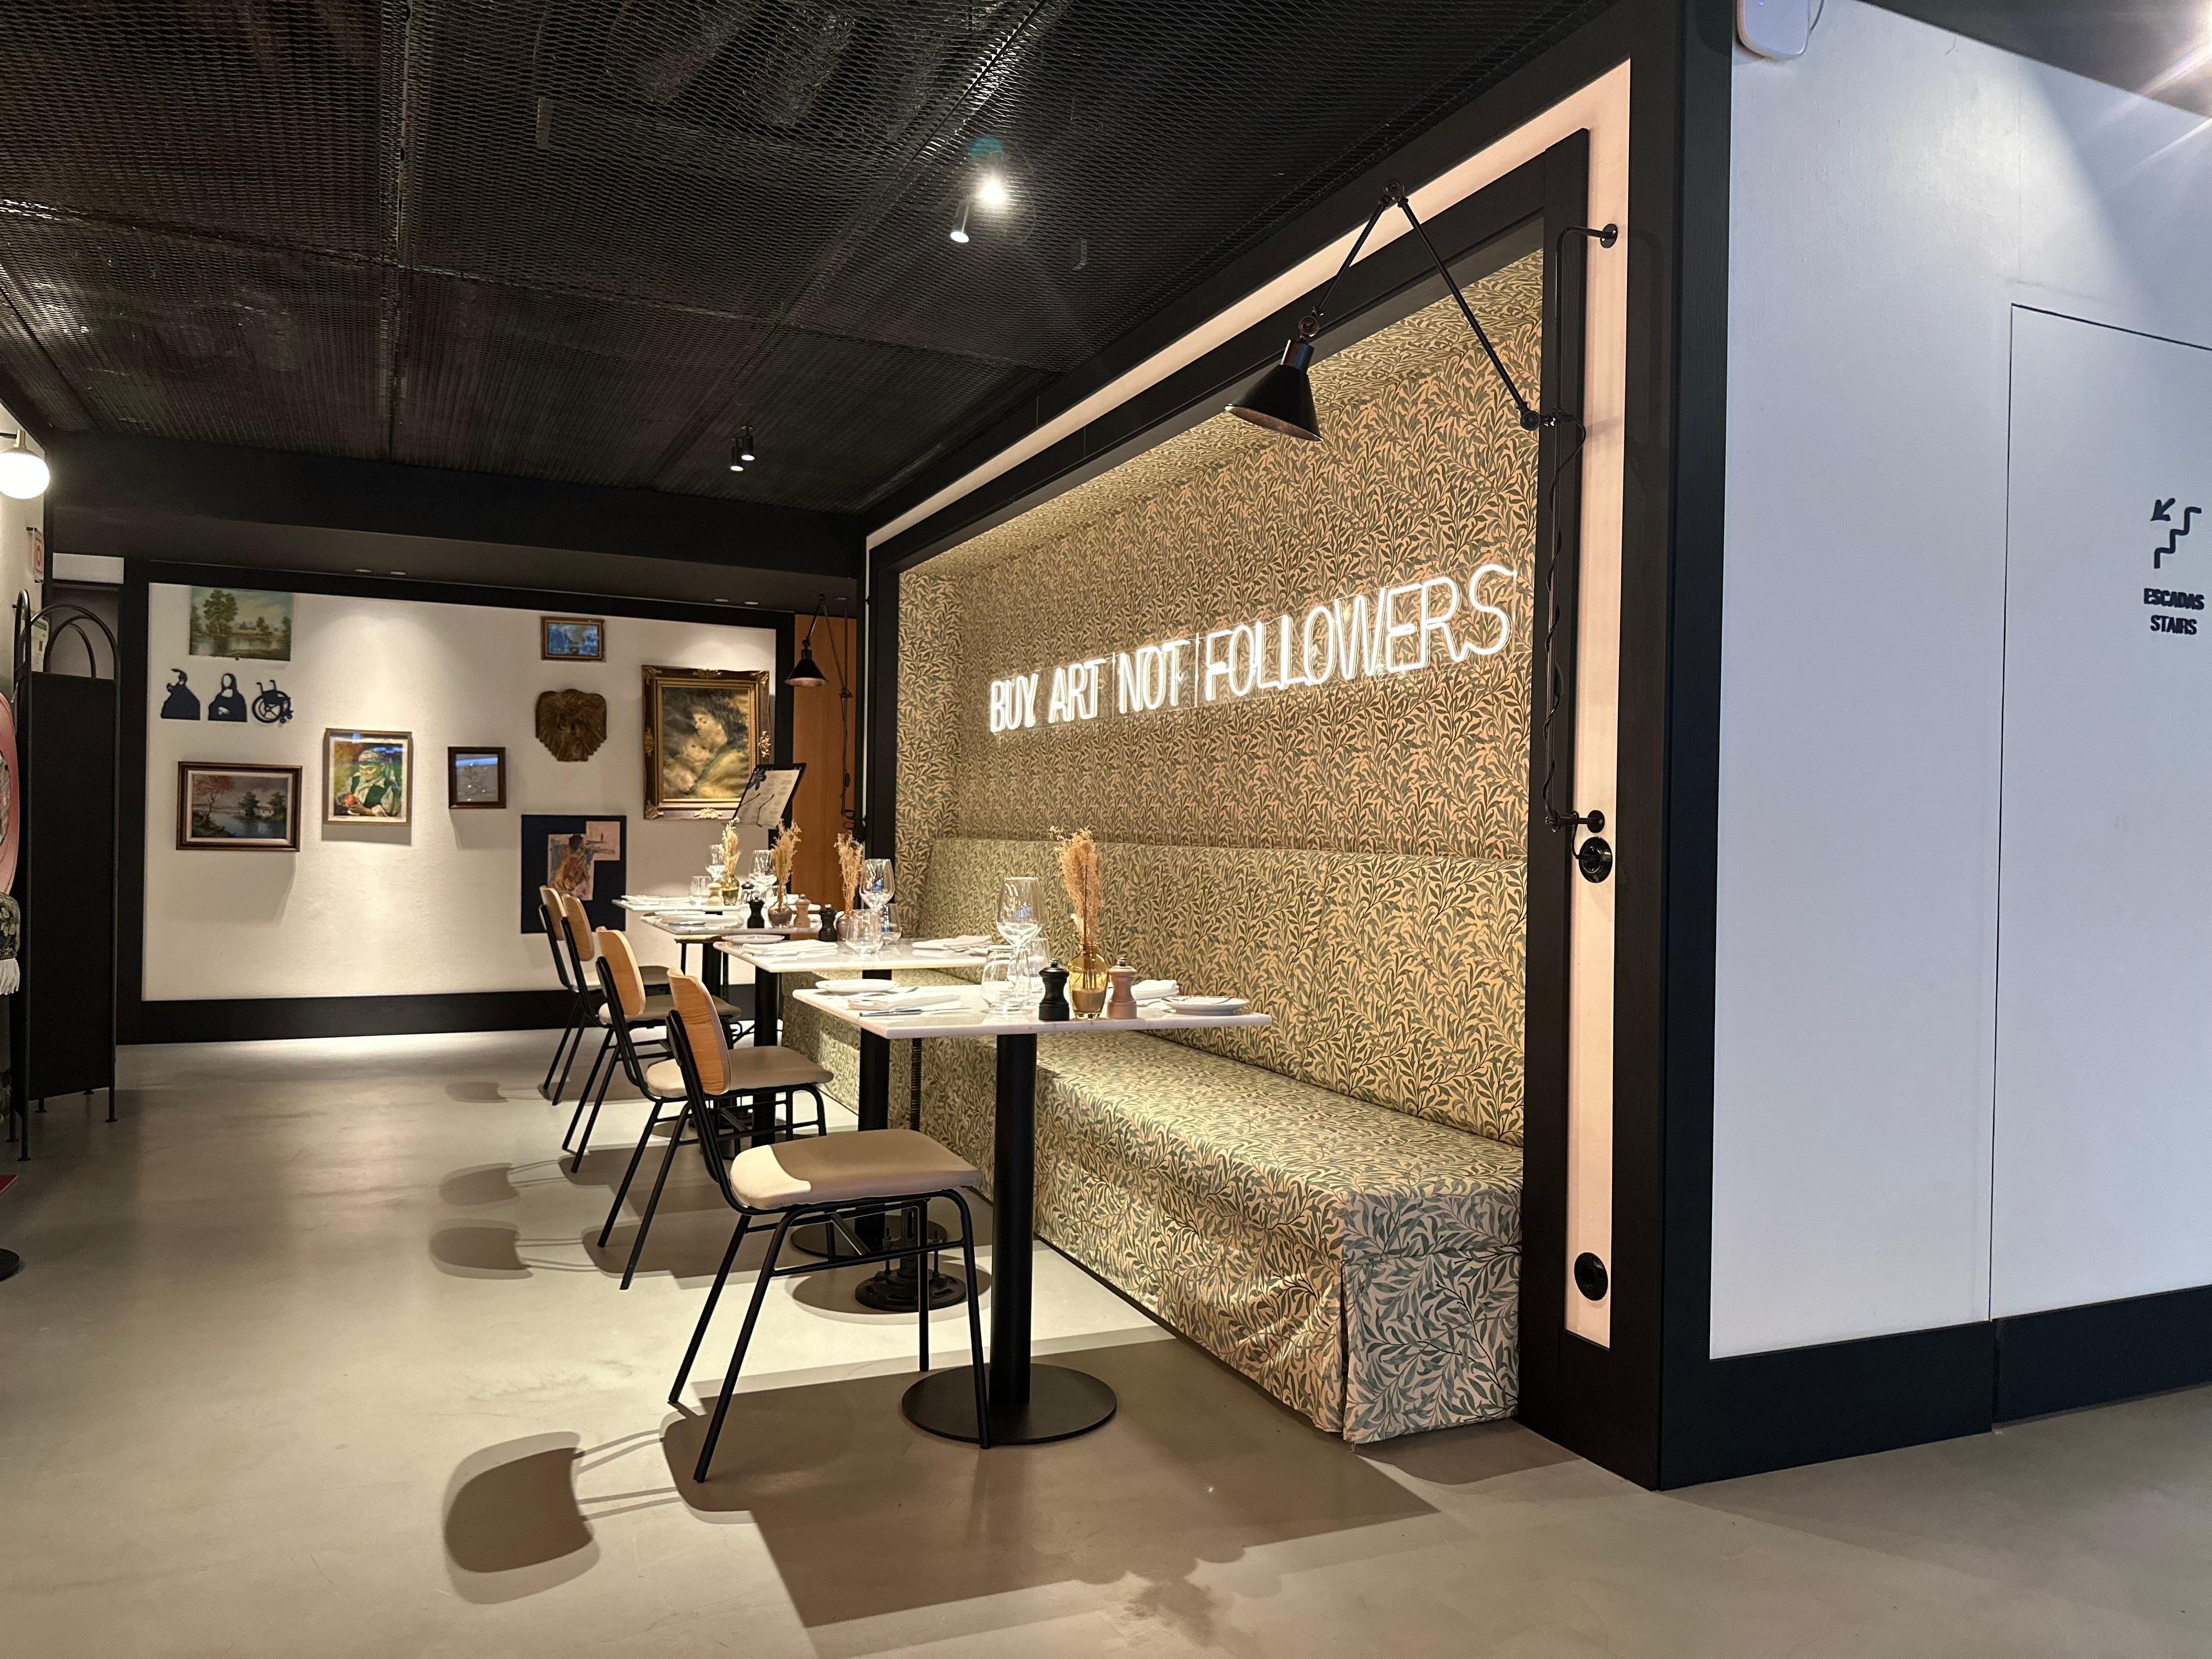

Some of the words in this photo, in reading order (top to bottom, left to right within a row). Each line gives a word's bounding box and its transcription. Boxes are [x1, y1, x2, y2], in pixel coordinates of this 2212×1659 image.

[2144, 588, 2204, 610] ESCADAS
[2151, 615, 2197, 635] STAIRS
[991, 673, 1039, 732] BUY
[1048, 658, 1106, 723] ART
[1119, 640, 1190, 714] NOT
[1206, 564, 1516, 701] FOLLOWERS
